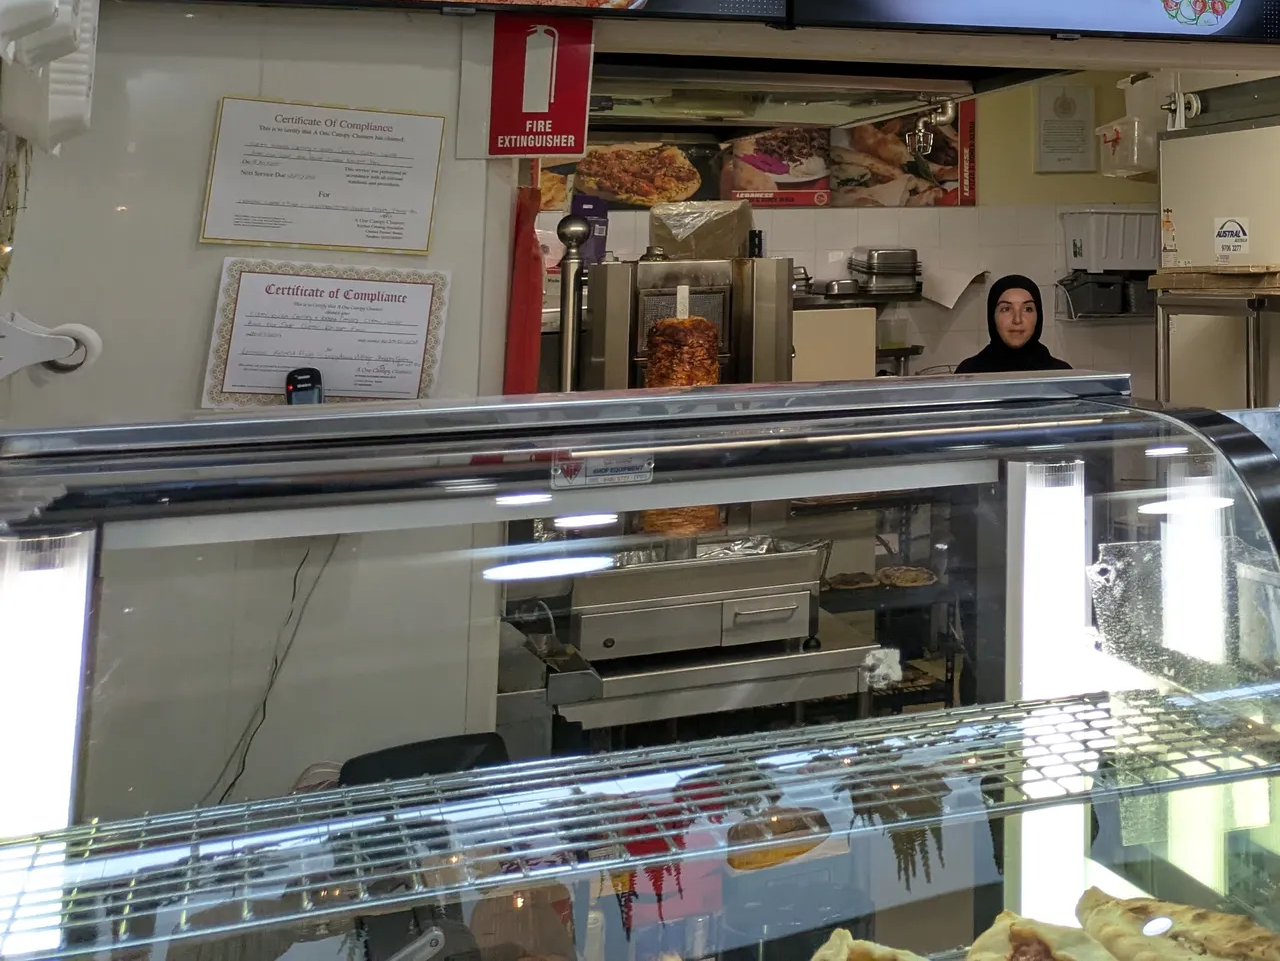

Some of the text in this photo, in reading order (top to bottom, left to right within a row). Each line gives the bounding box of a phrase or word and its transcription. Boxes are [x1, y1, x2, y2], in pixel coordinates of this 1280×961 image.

[275, 114, 393, 132] Certificate Of Compliance
[526, 120, 552, 132] FIRE
[498, 135, 575, 148] EXTINGUISHER
[1216, 230, 1241, 238] AUSTRAL
[265, 284, 407, 303] Certificate of Compliance
